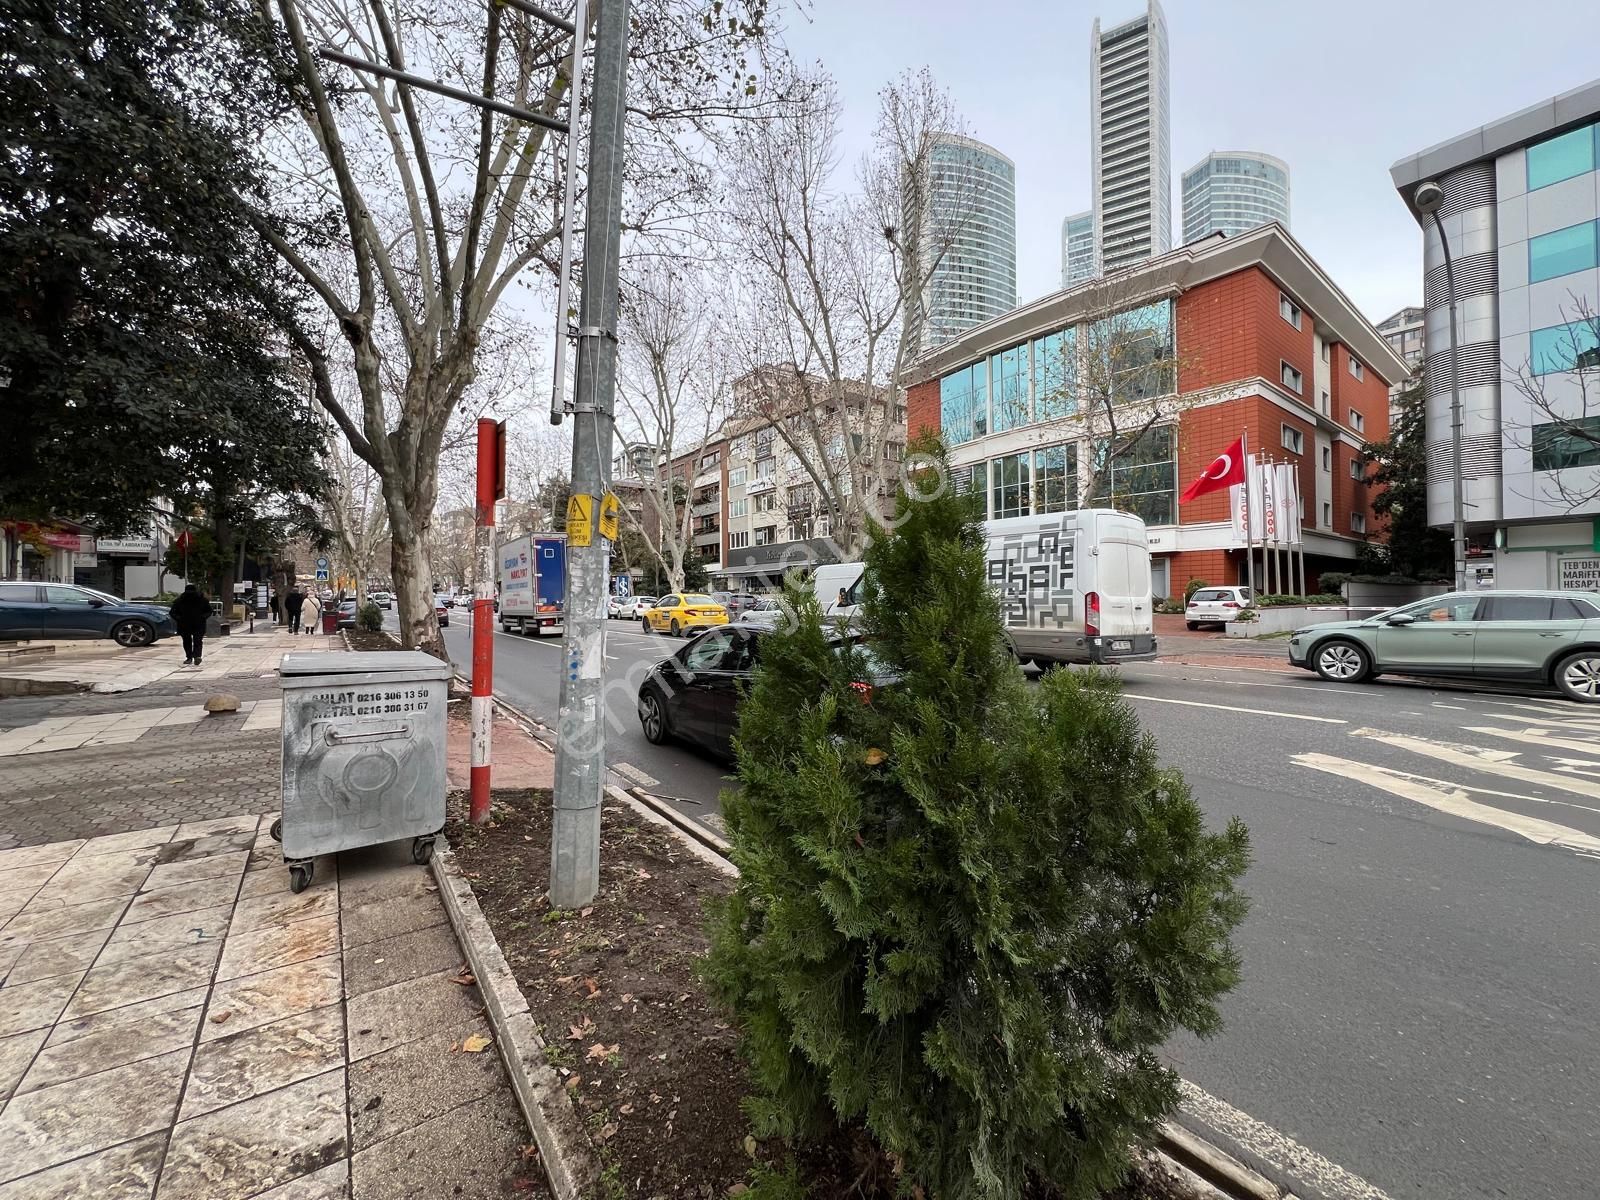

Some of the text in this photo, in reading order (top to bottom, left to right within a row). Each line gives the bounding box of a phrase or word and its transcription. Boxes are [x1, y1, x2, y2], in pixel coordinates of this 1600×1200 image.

[1564, 561, 1599, 570] TEB'DEN
[357, 693, 381, 703] 0216
[384, 691, 402, 700] 306
[404, 690, 415, 699] 13
[417, 689, 429, 698] 50
[357, 706, 382, 715] 0216
[384, 704, 402, 713] 306
[403, 703, 414, 711] 31
[417, 701, 429, 710] 67
